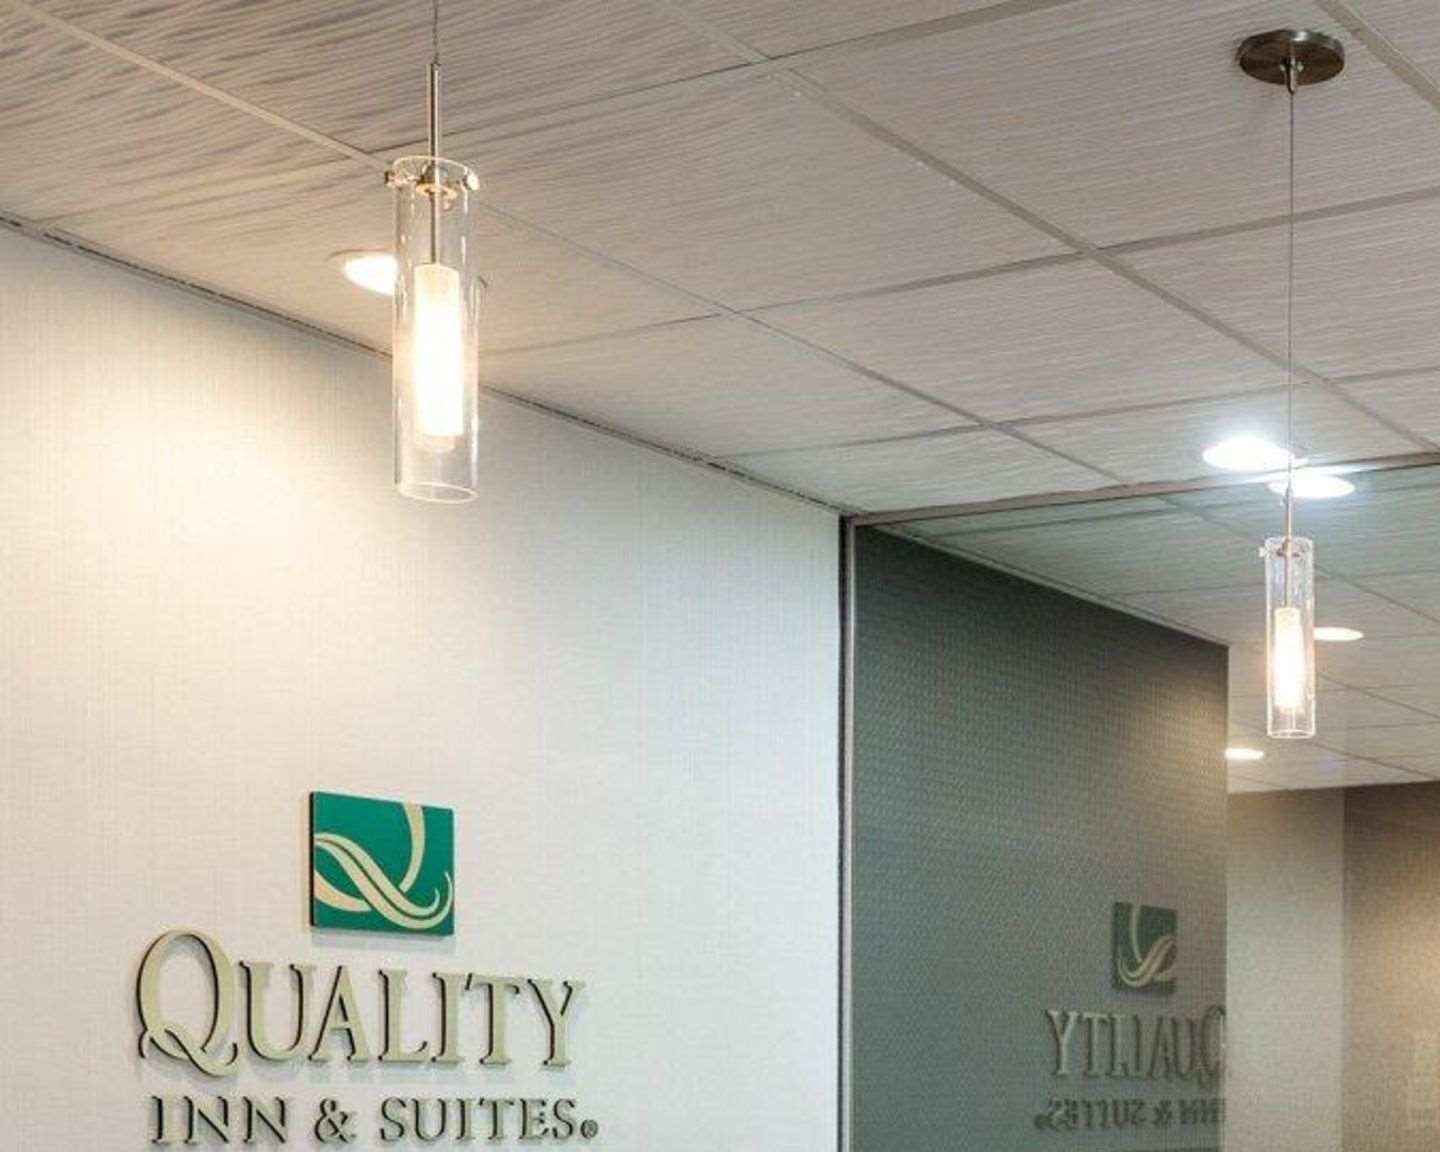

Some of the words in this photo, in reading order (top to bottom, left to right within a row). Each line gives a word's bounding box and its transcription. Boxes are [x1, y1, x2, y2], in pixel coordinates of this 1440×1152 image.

[135, 928, 587, 1077] QUALITY
[150, 1094, 288, 1144] INN
[314, 1096, 357, 1143] &
